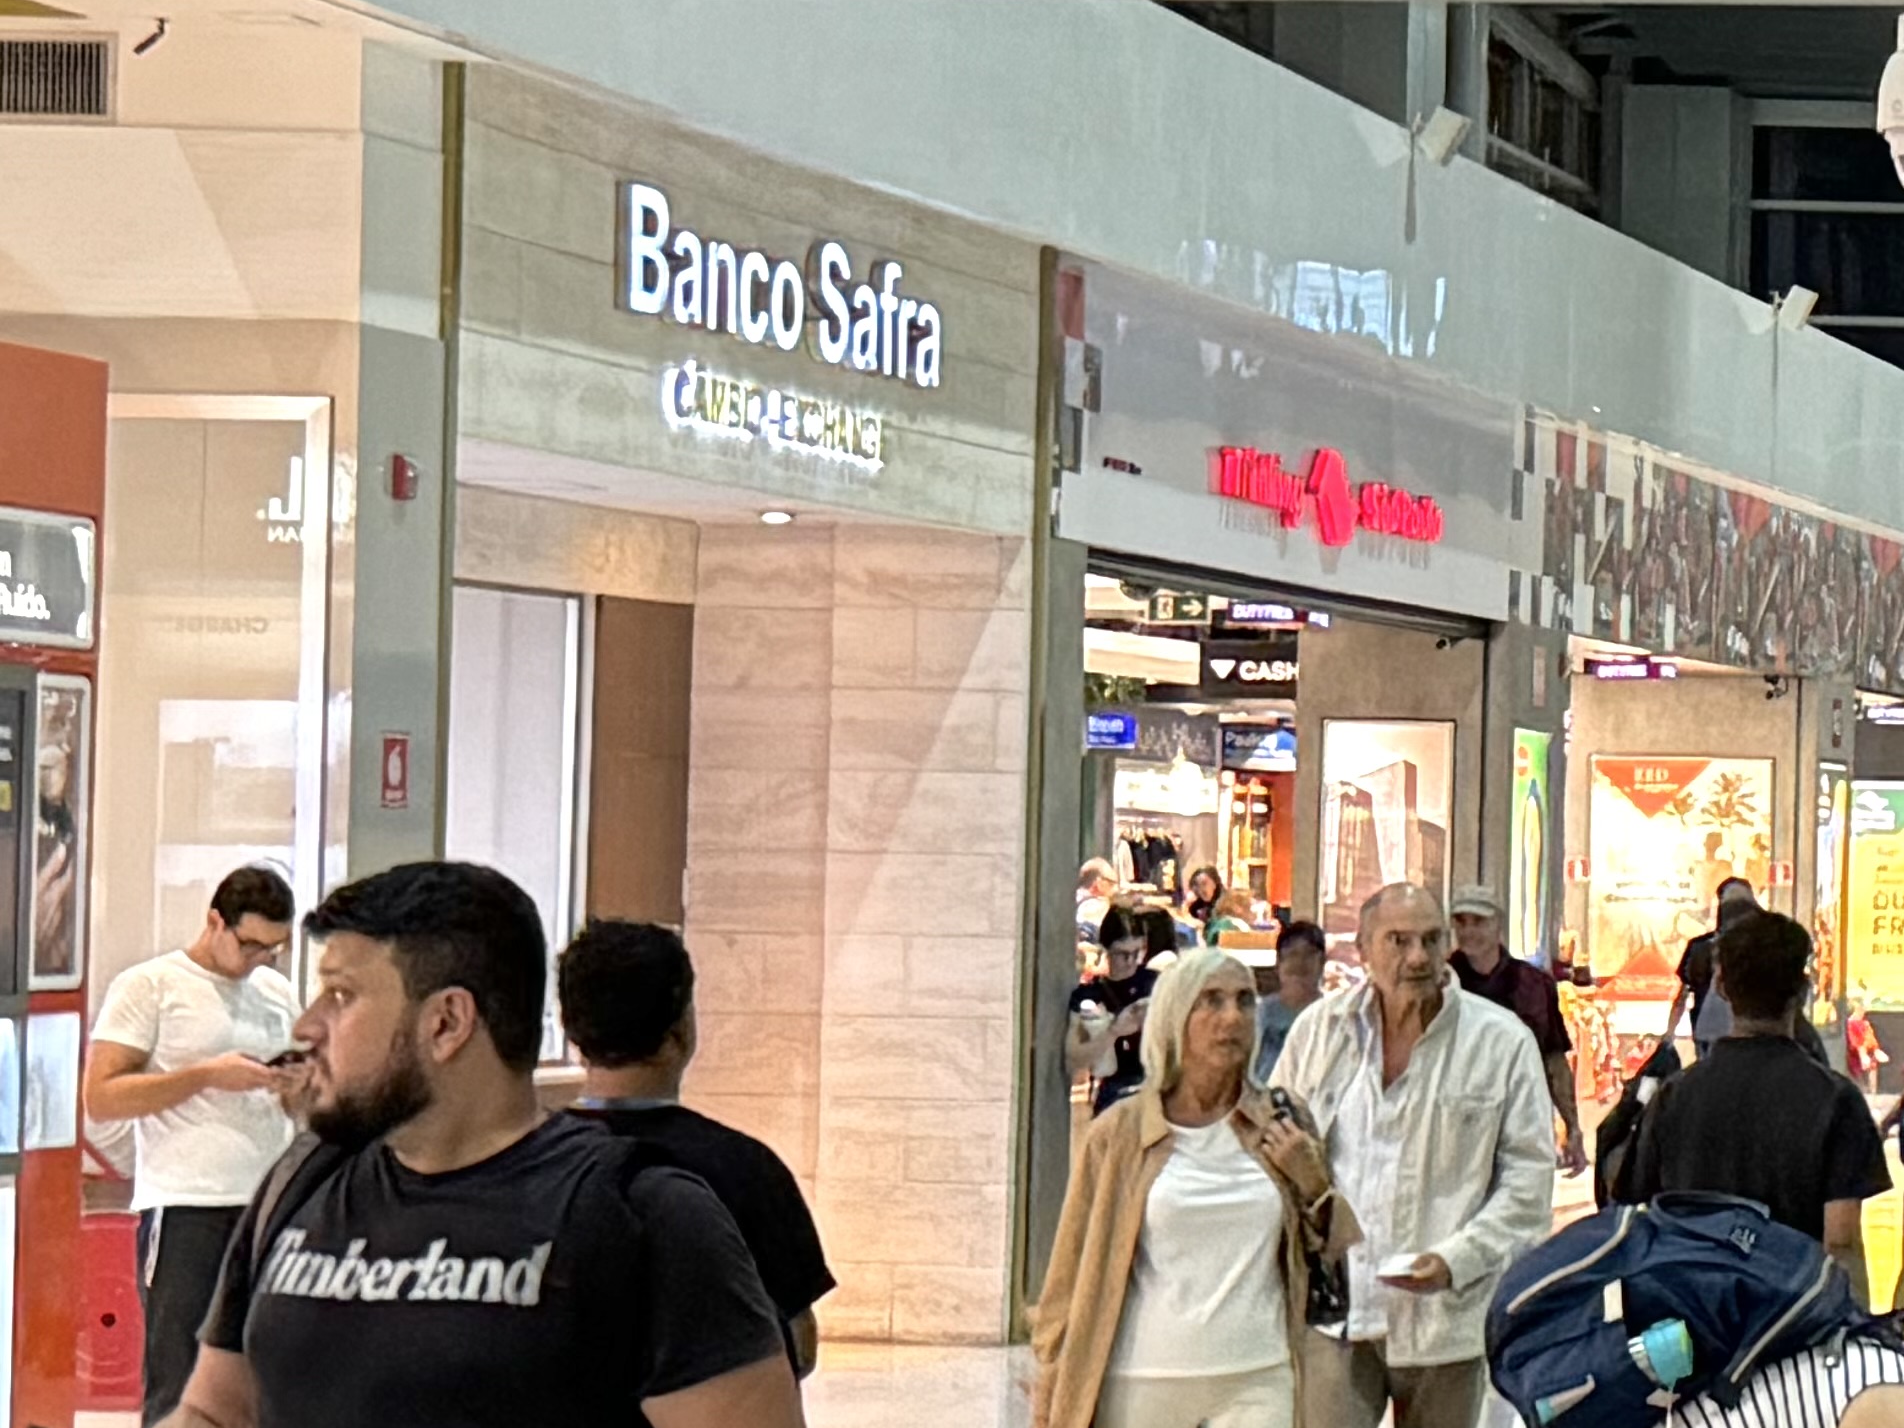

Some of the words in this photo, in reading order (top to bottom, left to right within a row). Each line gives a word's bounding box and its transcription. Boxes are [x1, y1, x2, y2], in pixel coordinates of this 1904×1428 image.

[631, 185, 802, 350] Banco
[820, 243, 939, 386] Safra
[263, 1227, 553, 1308] Timberland
